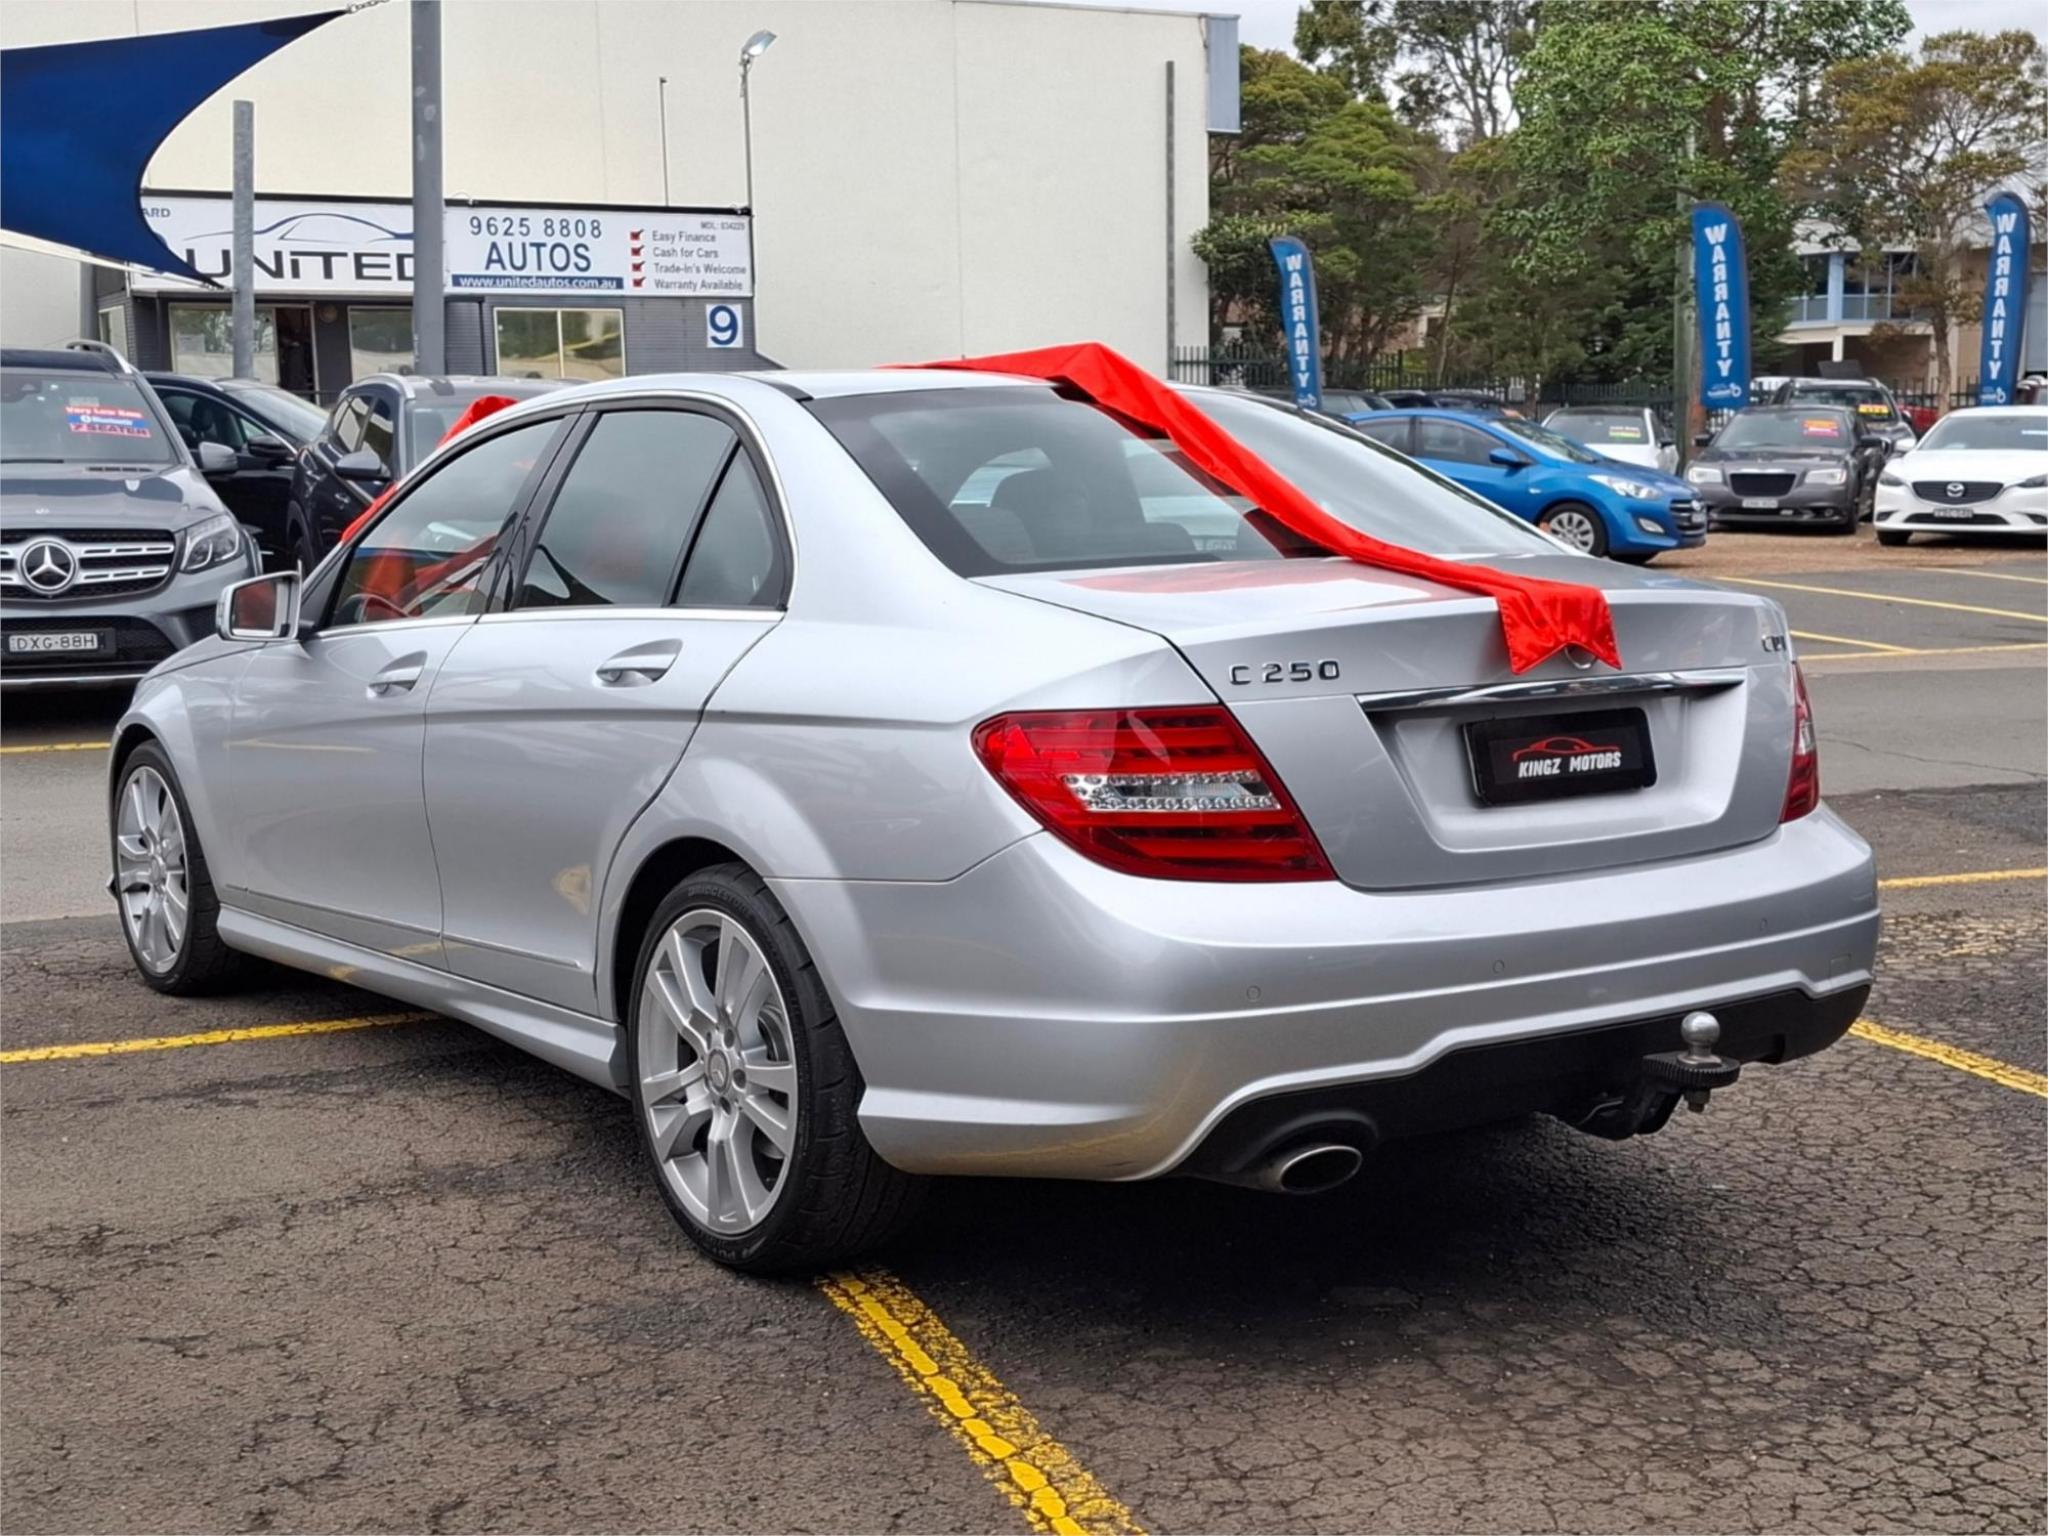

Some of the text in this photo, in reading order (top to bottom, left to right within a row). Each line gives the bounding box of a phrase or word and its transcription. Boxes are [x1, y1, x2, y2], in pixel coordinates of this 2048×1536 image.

[469, 215, 602, 238] 9625 8808
[652, 230, 716, 244] Easy Finance
[484, 241, 592, 272] AUTOS
[653, 247, 719, 258] Cash for Cars
[654, 262, 746, 274] Trade-In's Welcome
[459, 275, 617, 290] www.unitedautos.com.au
[654, 279, 743, 292] Warranty Available
[708, 304, 739, 346] 9
[1228, 659, 1340, 686] C 250
[1518, 751, 1622, 779] KINGZ MOTORS
